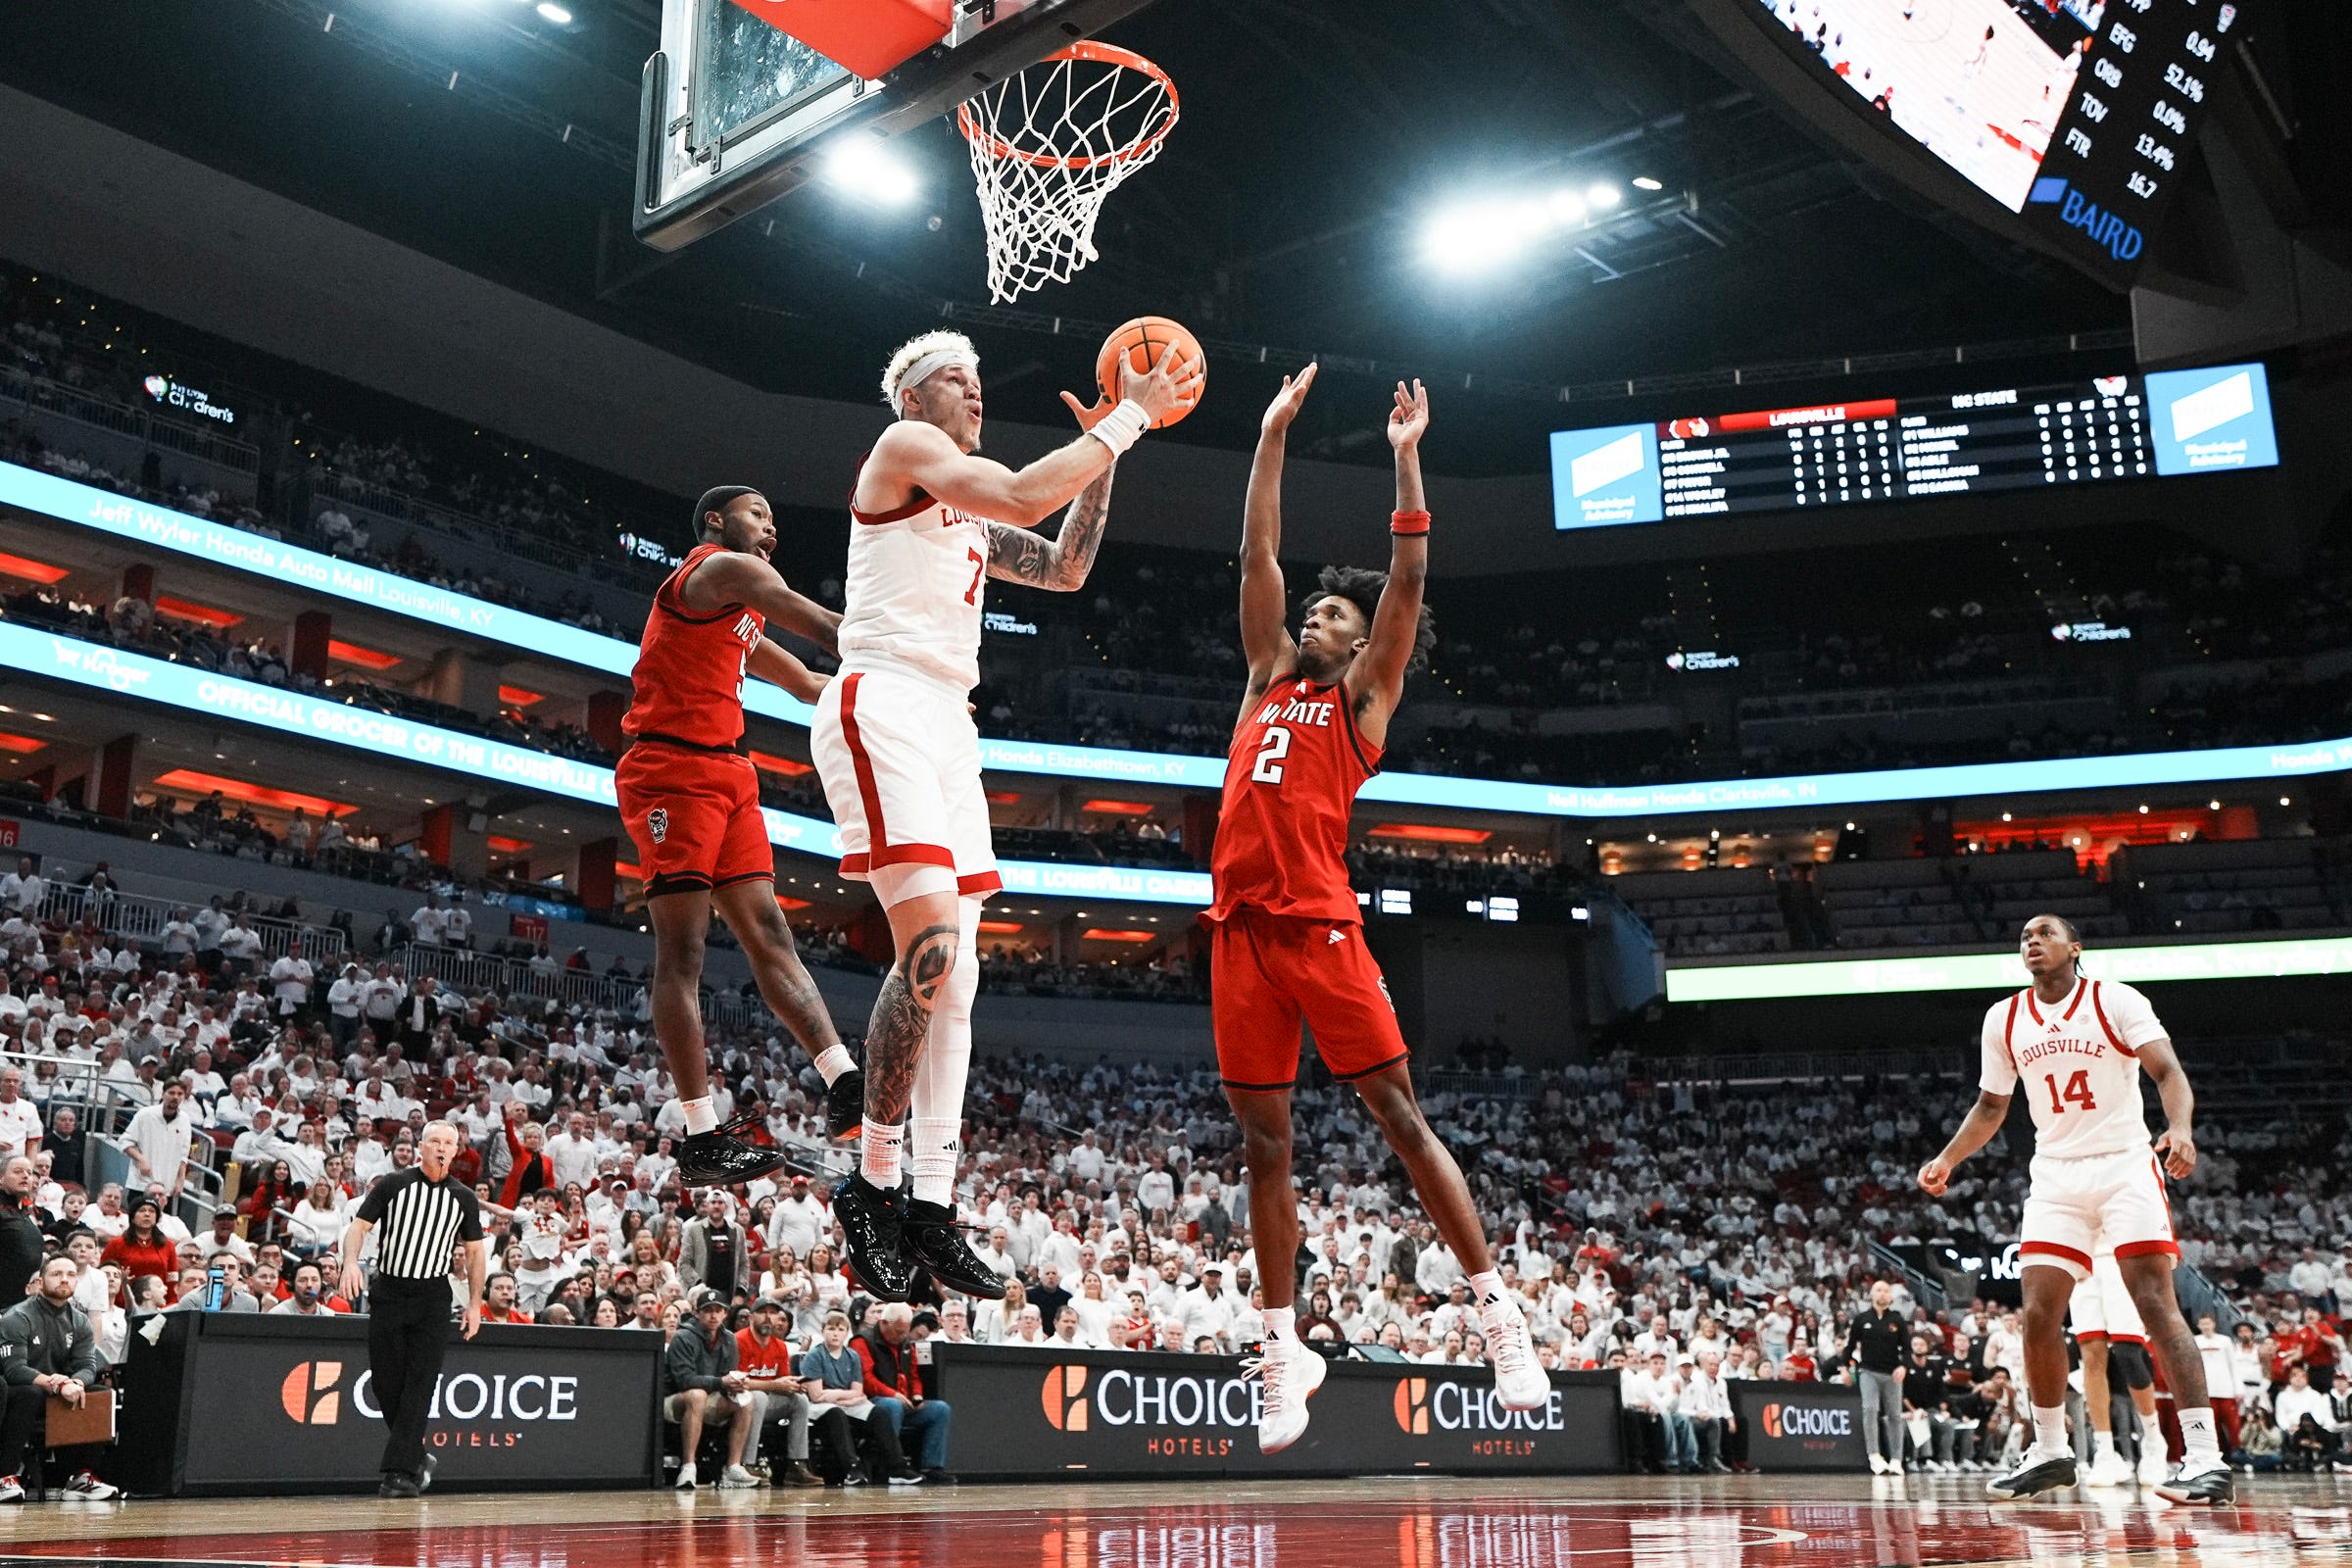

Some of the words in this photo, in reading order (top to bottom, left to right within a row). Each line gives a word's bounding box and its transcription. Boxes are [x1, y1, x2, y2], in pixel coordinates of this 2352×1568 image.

[2093, 58, 2123, 88] ORB
[2109, 22, 2137, 53] EFG
[2164, 63, 2204, 103] 52.1%
[2080, 91, 2109, 122] TOV
[2134, 133, 2175, 172] 13.4%
[2065, 126, 2092, 159] FTR
[2126, 171, 2157, 199] 16.7
[2060, 189, 2143, 260] BAIRD
[1952, 395, 1973, 409] NC
[1974, 390, 2017, 406] STATE
[1769, 407, 1845, 425] LOUISVILLE
[88, 499, 133, 526] Jeff
[138, 511, 202, 546] Wyler
[206, 530, 274, 567] Honda
[278, 553, 327, 582] Auto
[333, 568, 374, 596] Mall
[378, 580, 466, 623] Louisville,
[469, 607, 495, 628] KY
[964, 546, 984, 607] 7
[732, 612, 757, 642] NC
[83, 648, 151, 691] Kroger
[197, 680, 306, 725] OFFICIAL
[312, 708, 407, 749] GROCER
[414, 732, 442, 756] OF
[447, 739, 484, 765] THE
[492, 750, 596, 793] LOUISVILLE
[989, 746, 1044, 765] Honda
[1047, 752, 1160, 777] Elizabethtown,
[1164, 760, 1187, 776] KY
[1251, 726, 1292, 785] 2
[2271, 748, 2334, 769] Honda
[1651, 788, 1706, 805] Honda
[1798, 783, 1817, 798] IN
[1003, 867, 1037, 887] THE
[1043, 867, 1143, 893] LOUISVILLE
[2017, 1039, 2106, 1066] LOUISVILLE
[2044, 1069, 2097, 1113] 14
[1783, 1405, 1852, 1436] CHOICE
[422, 1431, 515, 1447] OTELS
[1149, 1438, 1229, 1456] HOTELS
[1472, 1440, 1533, 1456] HOTELS
